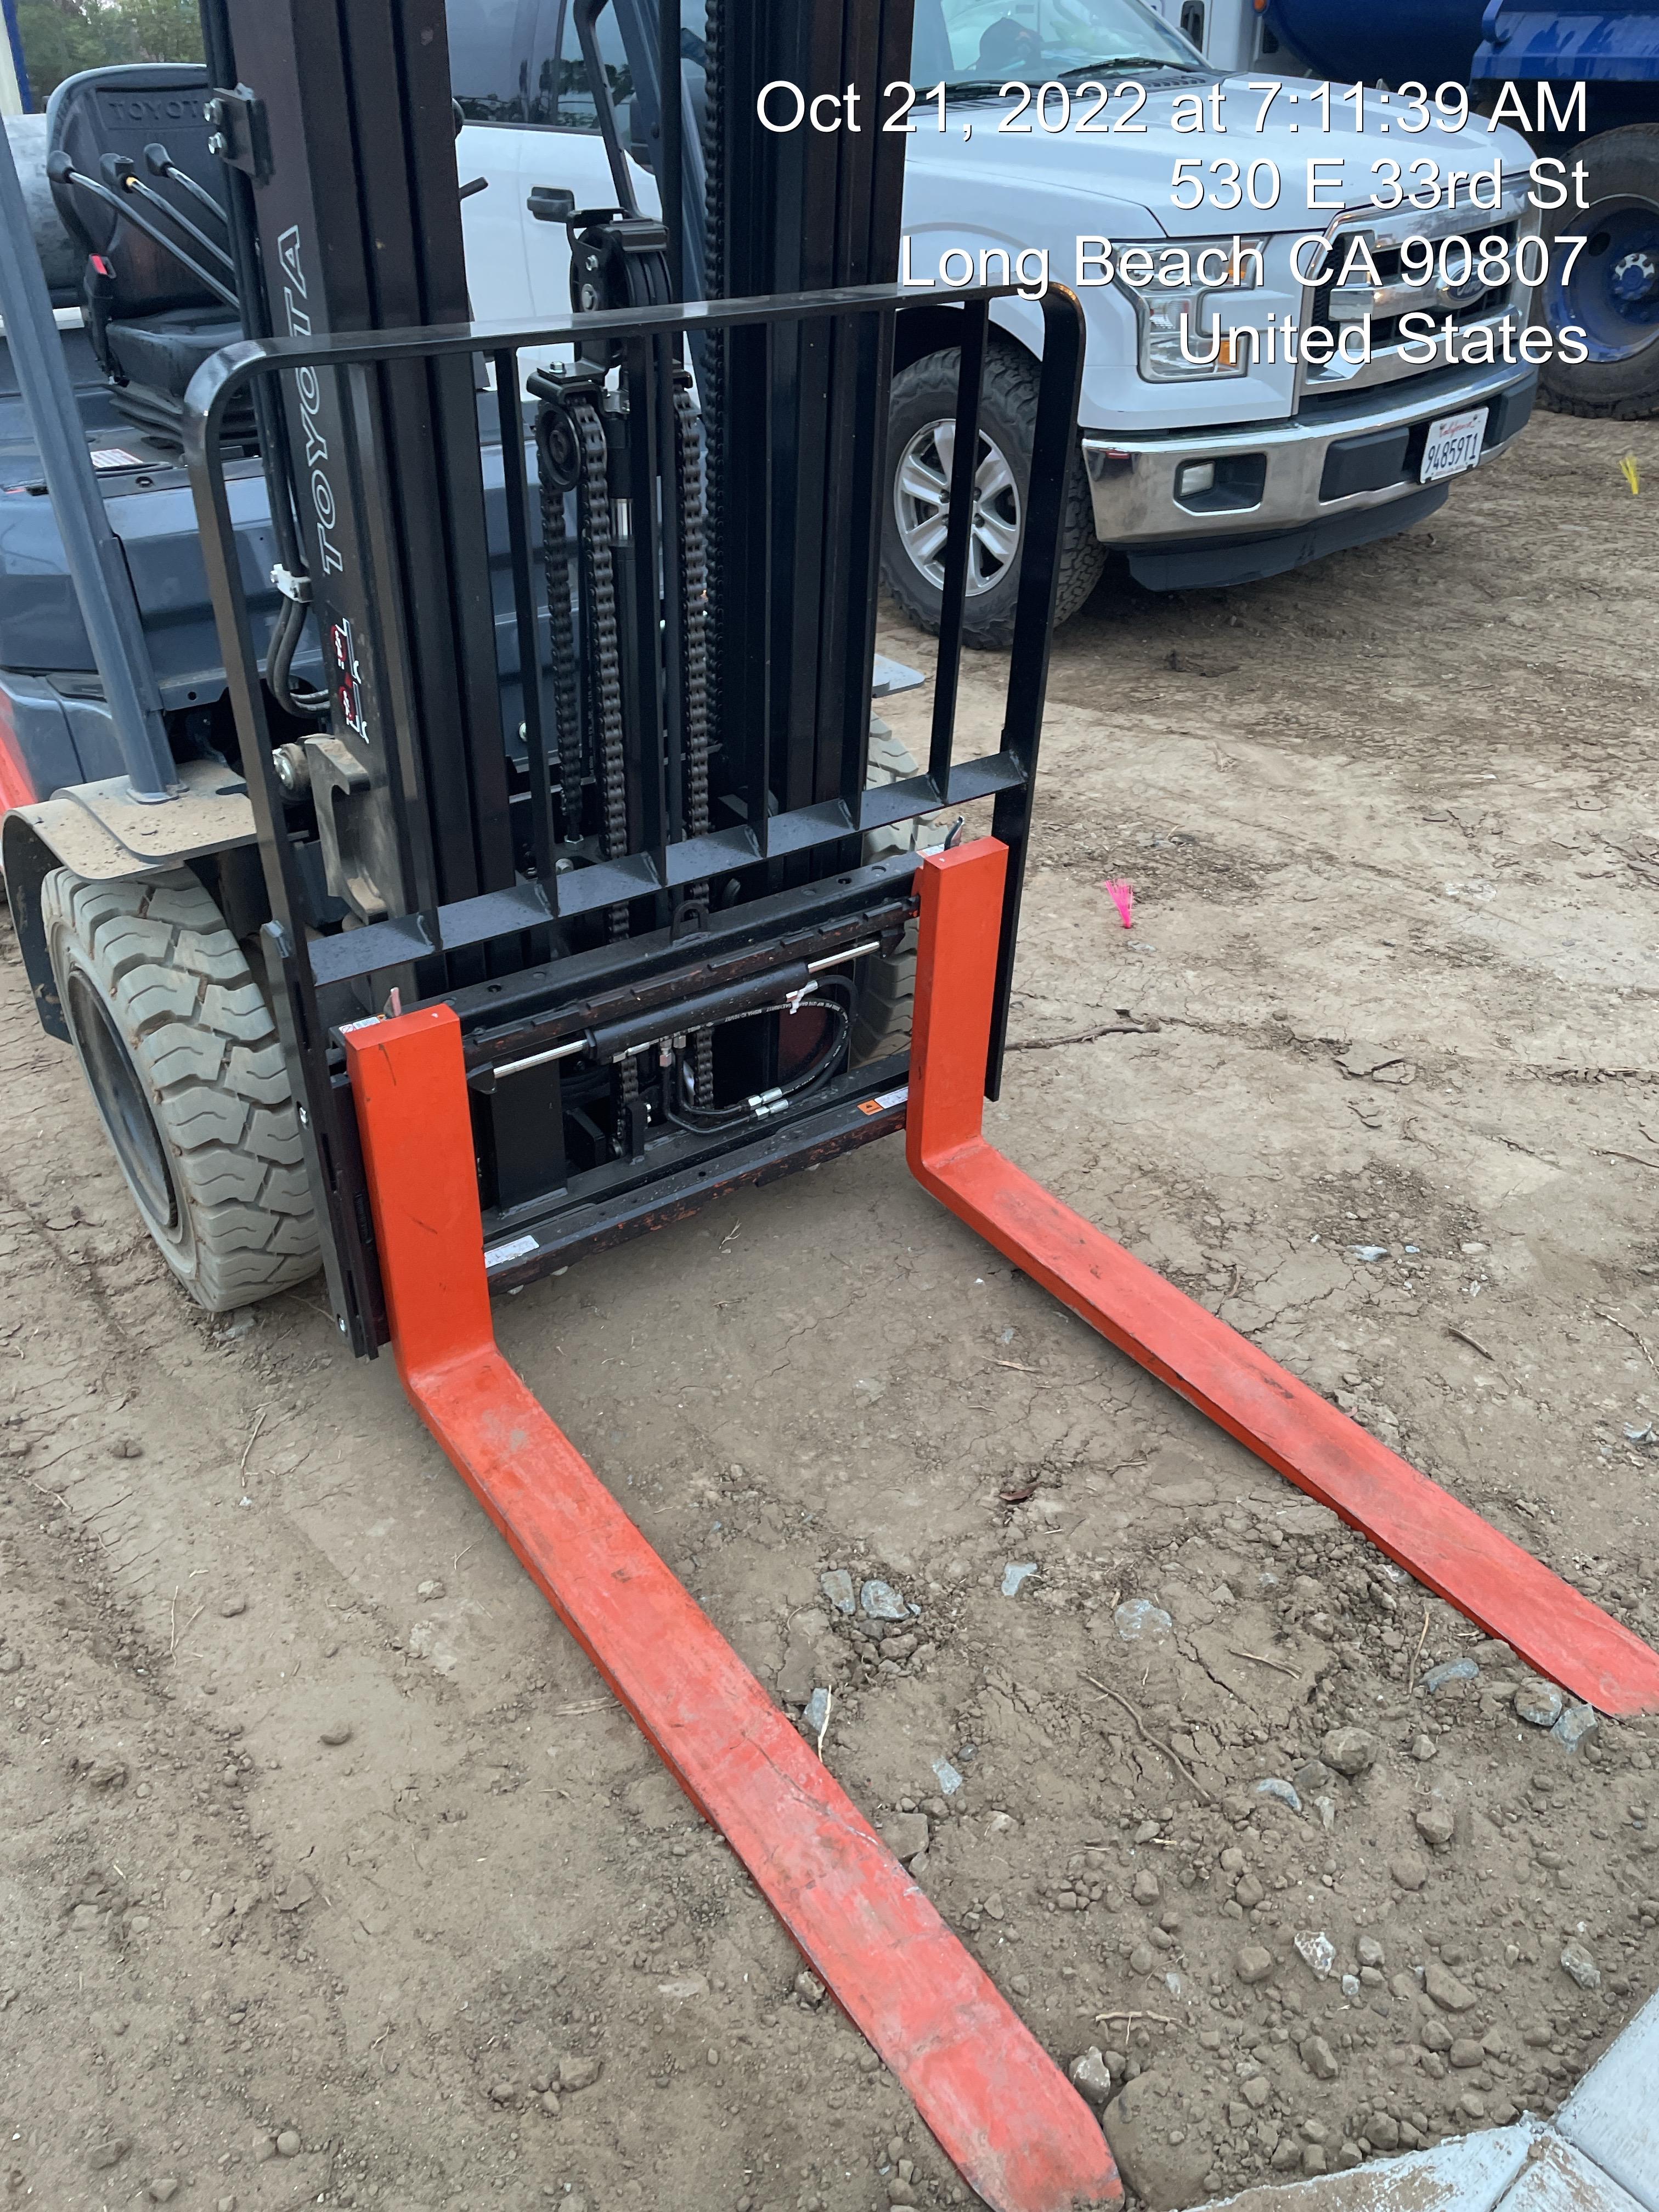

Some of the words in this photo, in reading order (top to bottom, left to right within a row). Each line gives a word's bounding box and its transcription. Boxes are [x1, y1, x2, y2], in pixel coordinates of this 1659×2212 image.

[109, 100, 200, 121] TOYOT
[278, 224, 343, 574] TOYOTA
[1425, 433, 1478, 473] 94859T1
